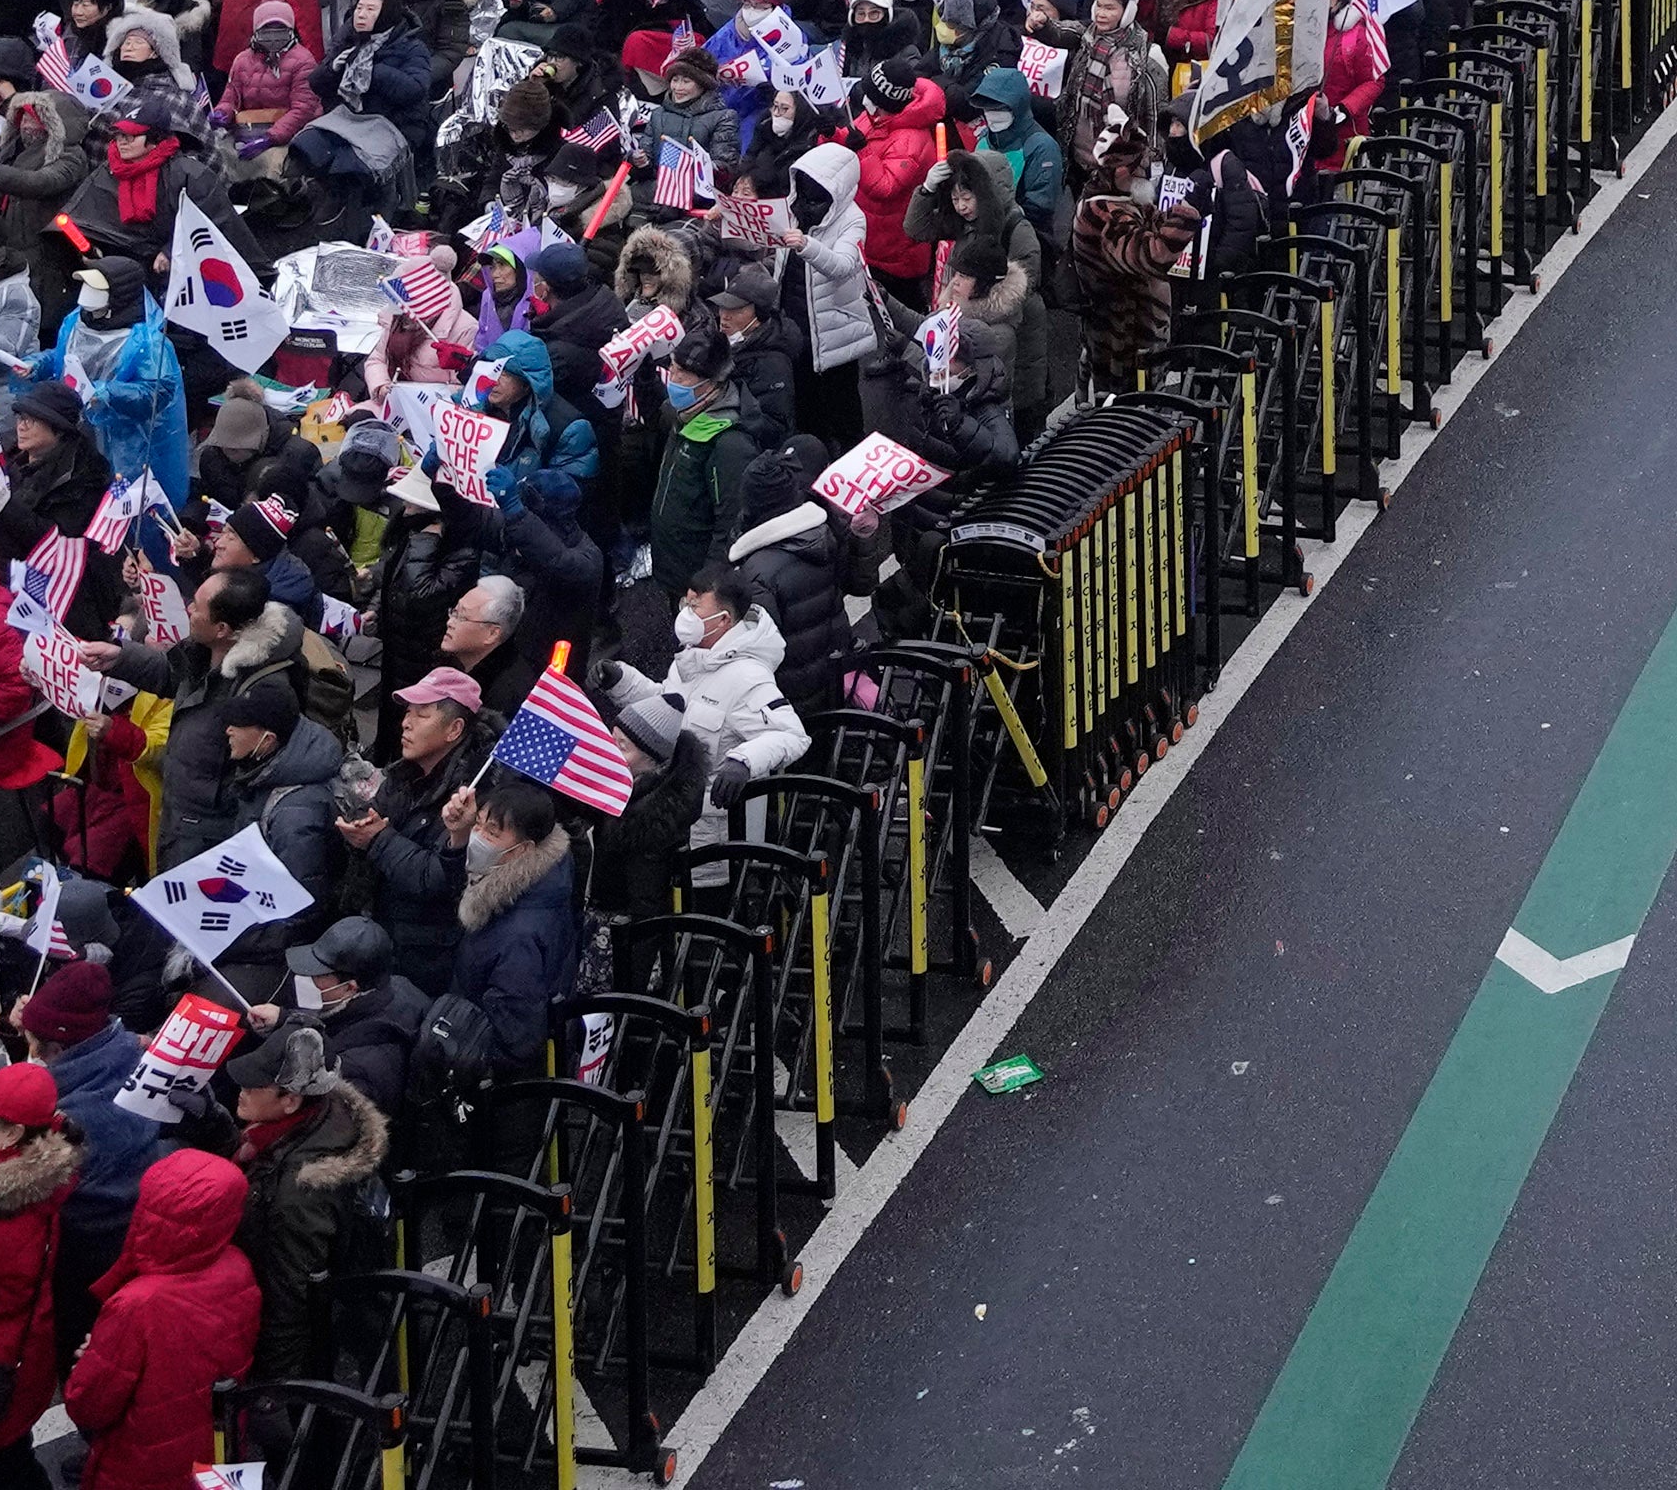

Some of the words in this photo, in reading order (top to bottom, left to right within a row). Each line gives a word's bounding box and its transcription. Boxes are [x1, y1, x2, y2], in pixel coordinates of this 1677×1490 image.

[718, 193, 775, 220] STOP
[737, 216, 775, 237] THE
[439, 408, 493, 444] STOP
[443, 441, 480, 472] THE
[864, 440, 932, 485] STOP
[1110, 540, 1119, 616] POLICE
[1082, 571, 1092, 649] POLICE
[41, 659, 80, 687] THE
[1112, 631, 1120, 679] LINE
